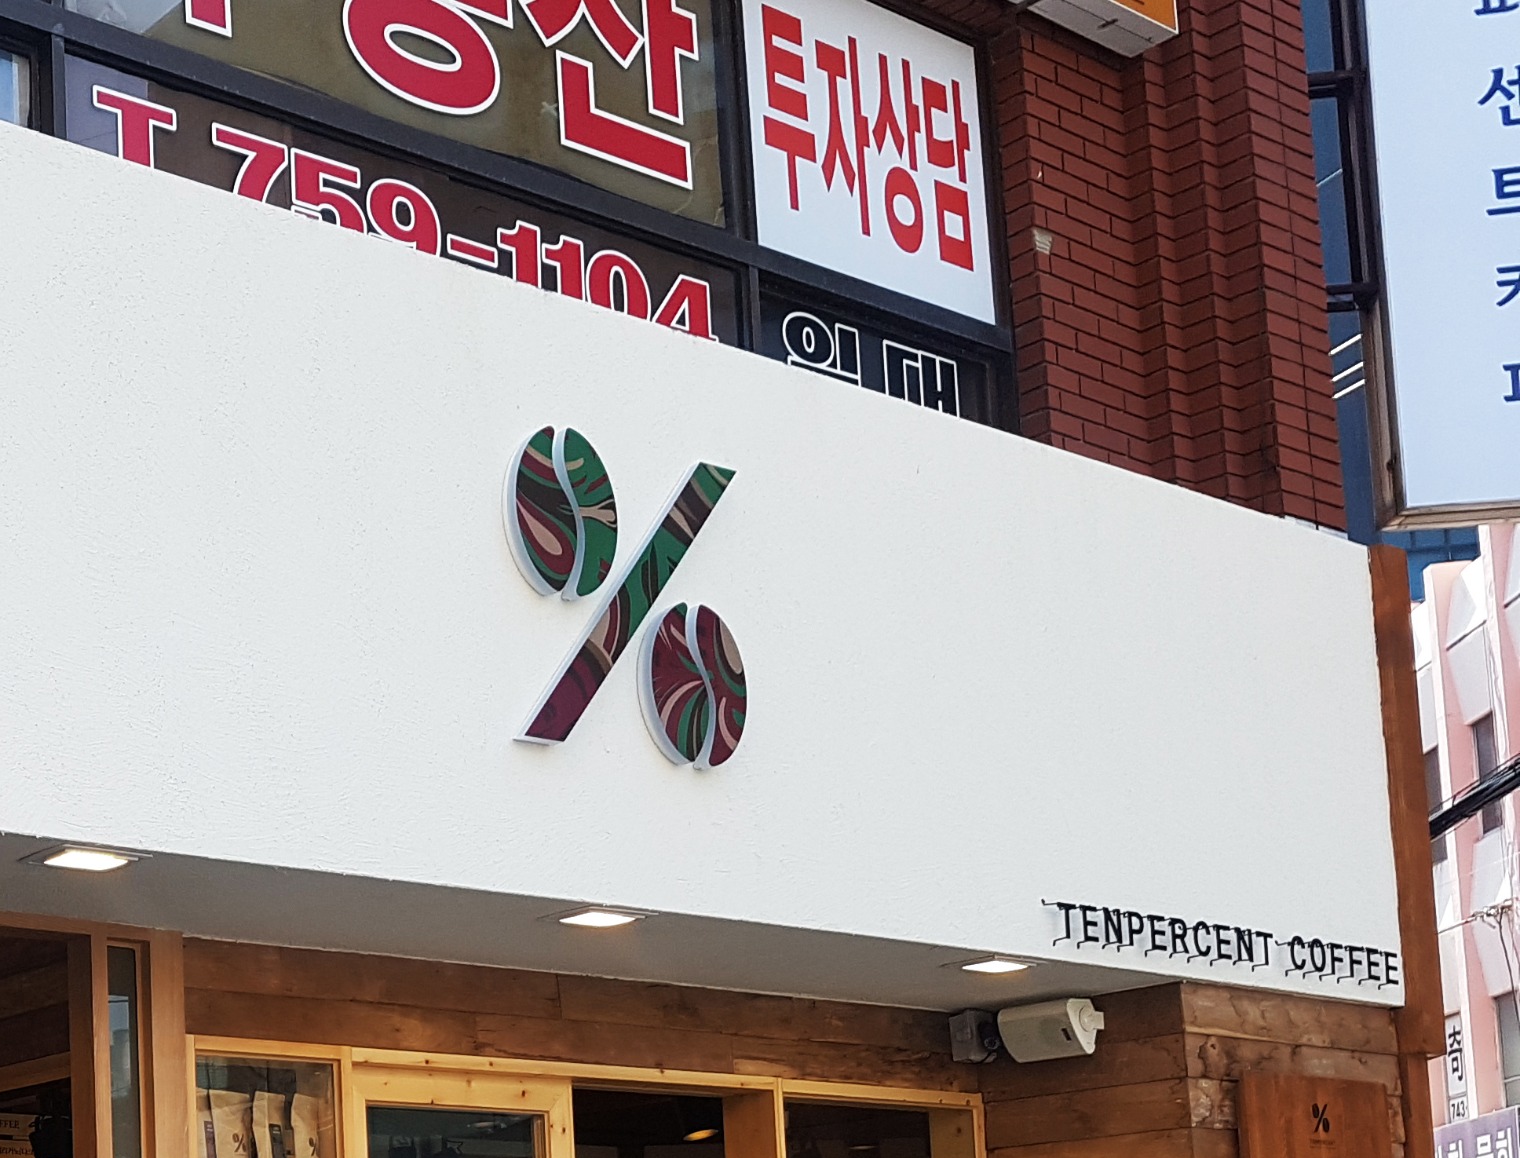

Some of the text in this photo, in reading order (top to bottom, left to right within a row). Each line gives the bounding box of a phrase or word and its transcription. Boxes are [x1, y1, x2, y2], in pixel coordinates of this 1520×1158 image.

[212, 122, 719, 343] 759-1104
[761, 2, 973, 272] 투자상담
[1053, 901, 1400, 986] TENPERCENT COFFEE
